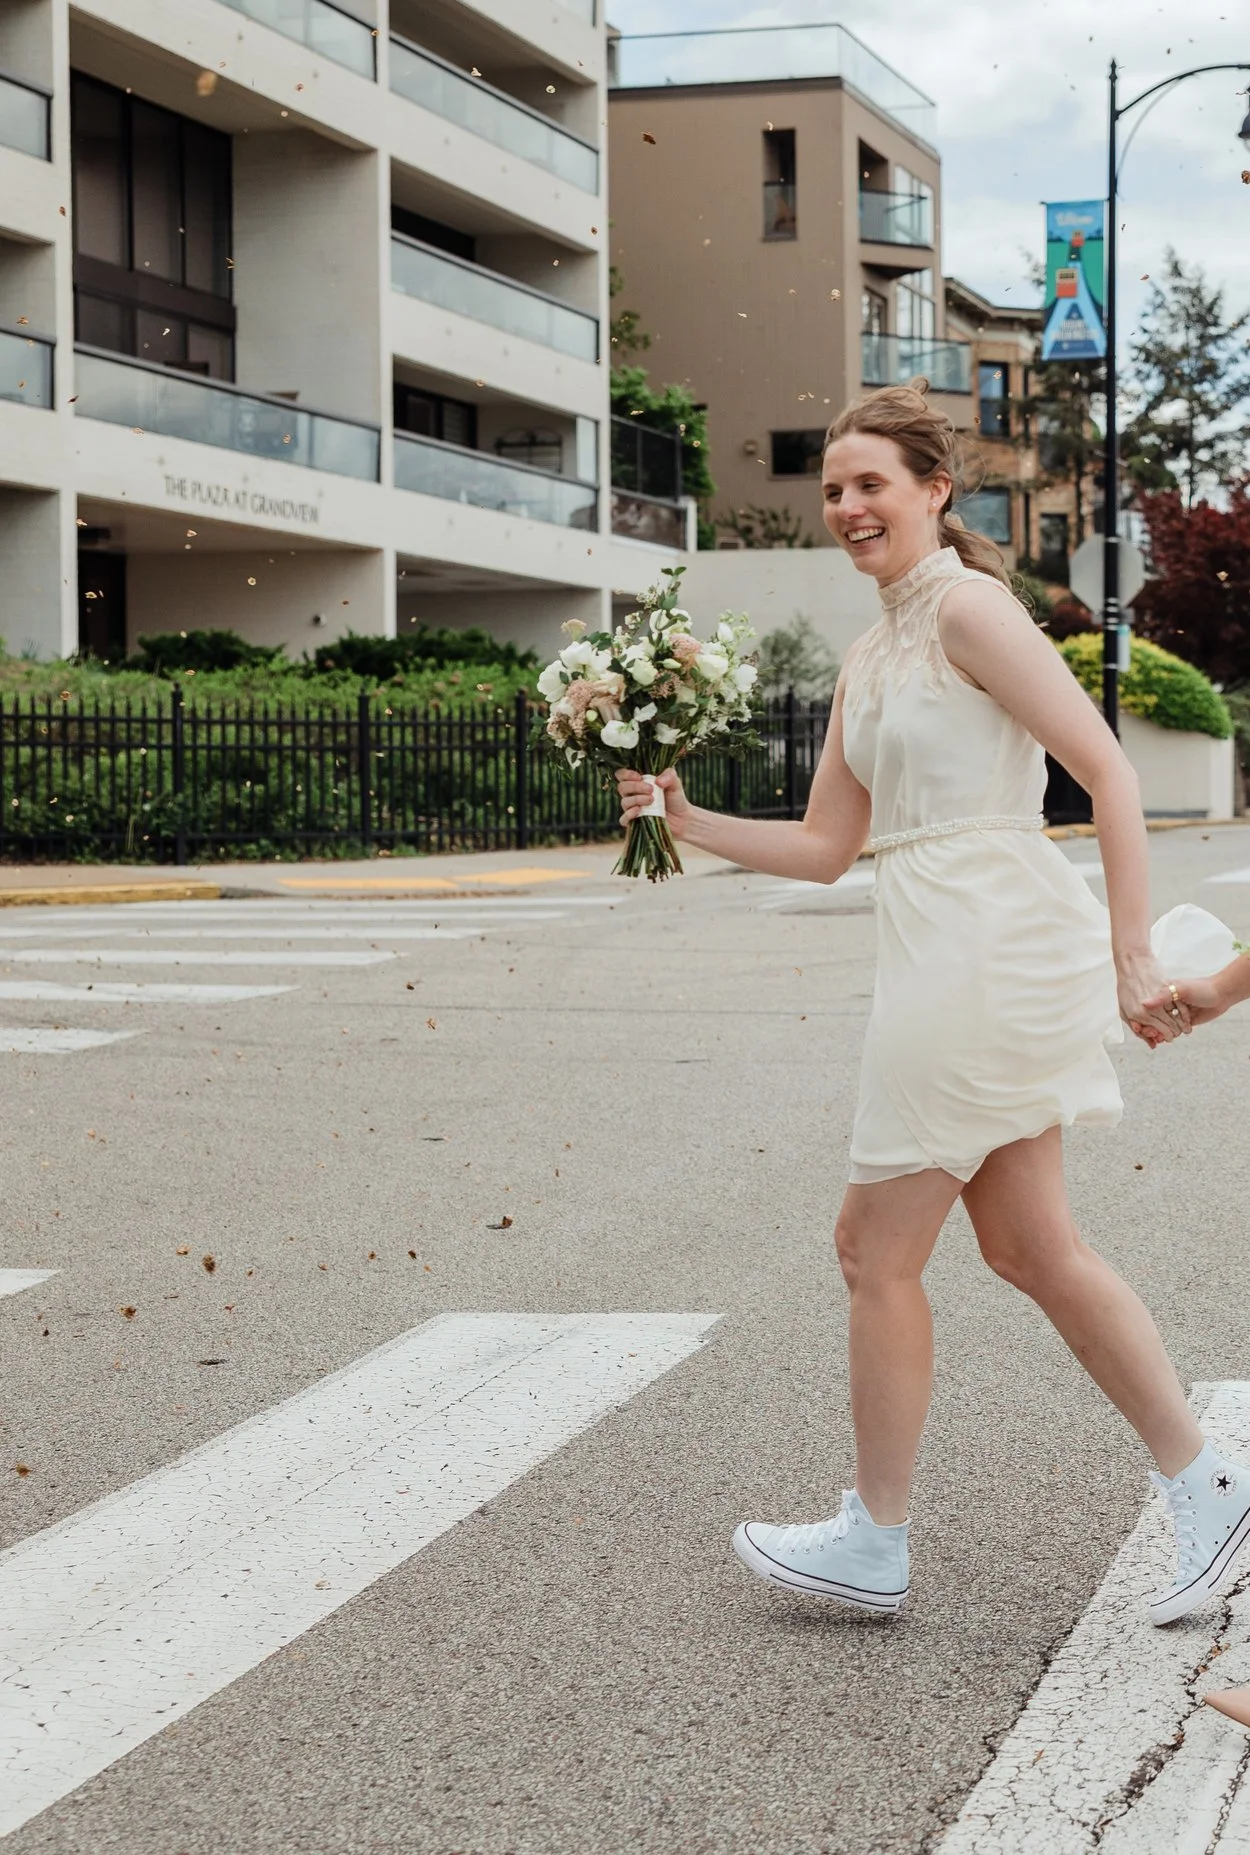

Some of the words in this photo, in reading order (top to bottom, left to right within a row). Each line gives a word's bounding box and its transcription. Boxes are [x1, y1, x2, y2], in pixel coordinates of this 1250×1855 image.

[165, 474, 187, 500] THE
[191, 481, 231, 507] PLAZA
[234, 489, 248, 510] AT
[251, 492, 320, 523] GRANDVIEW
